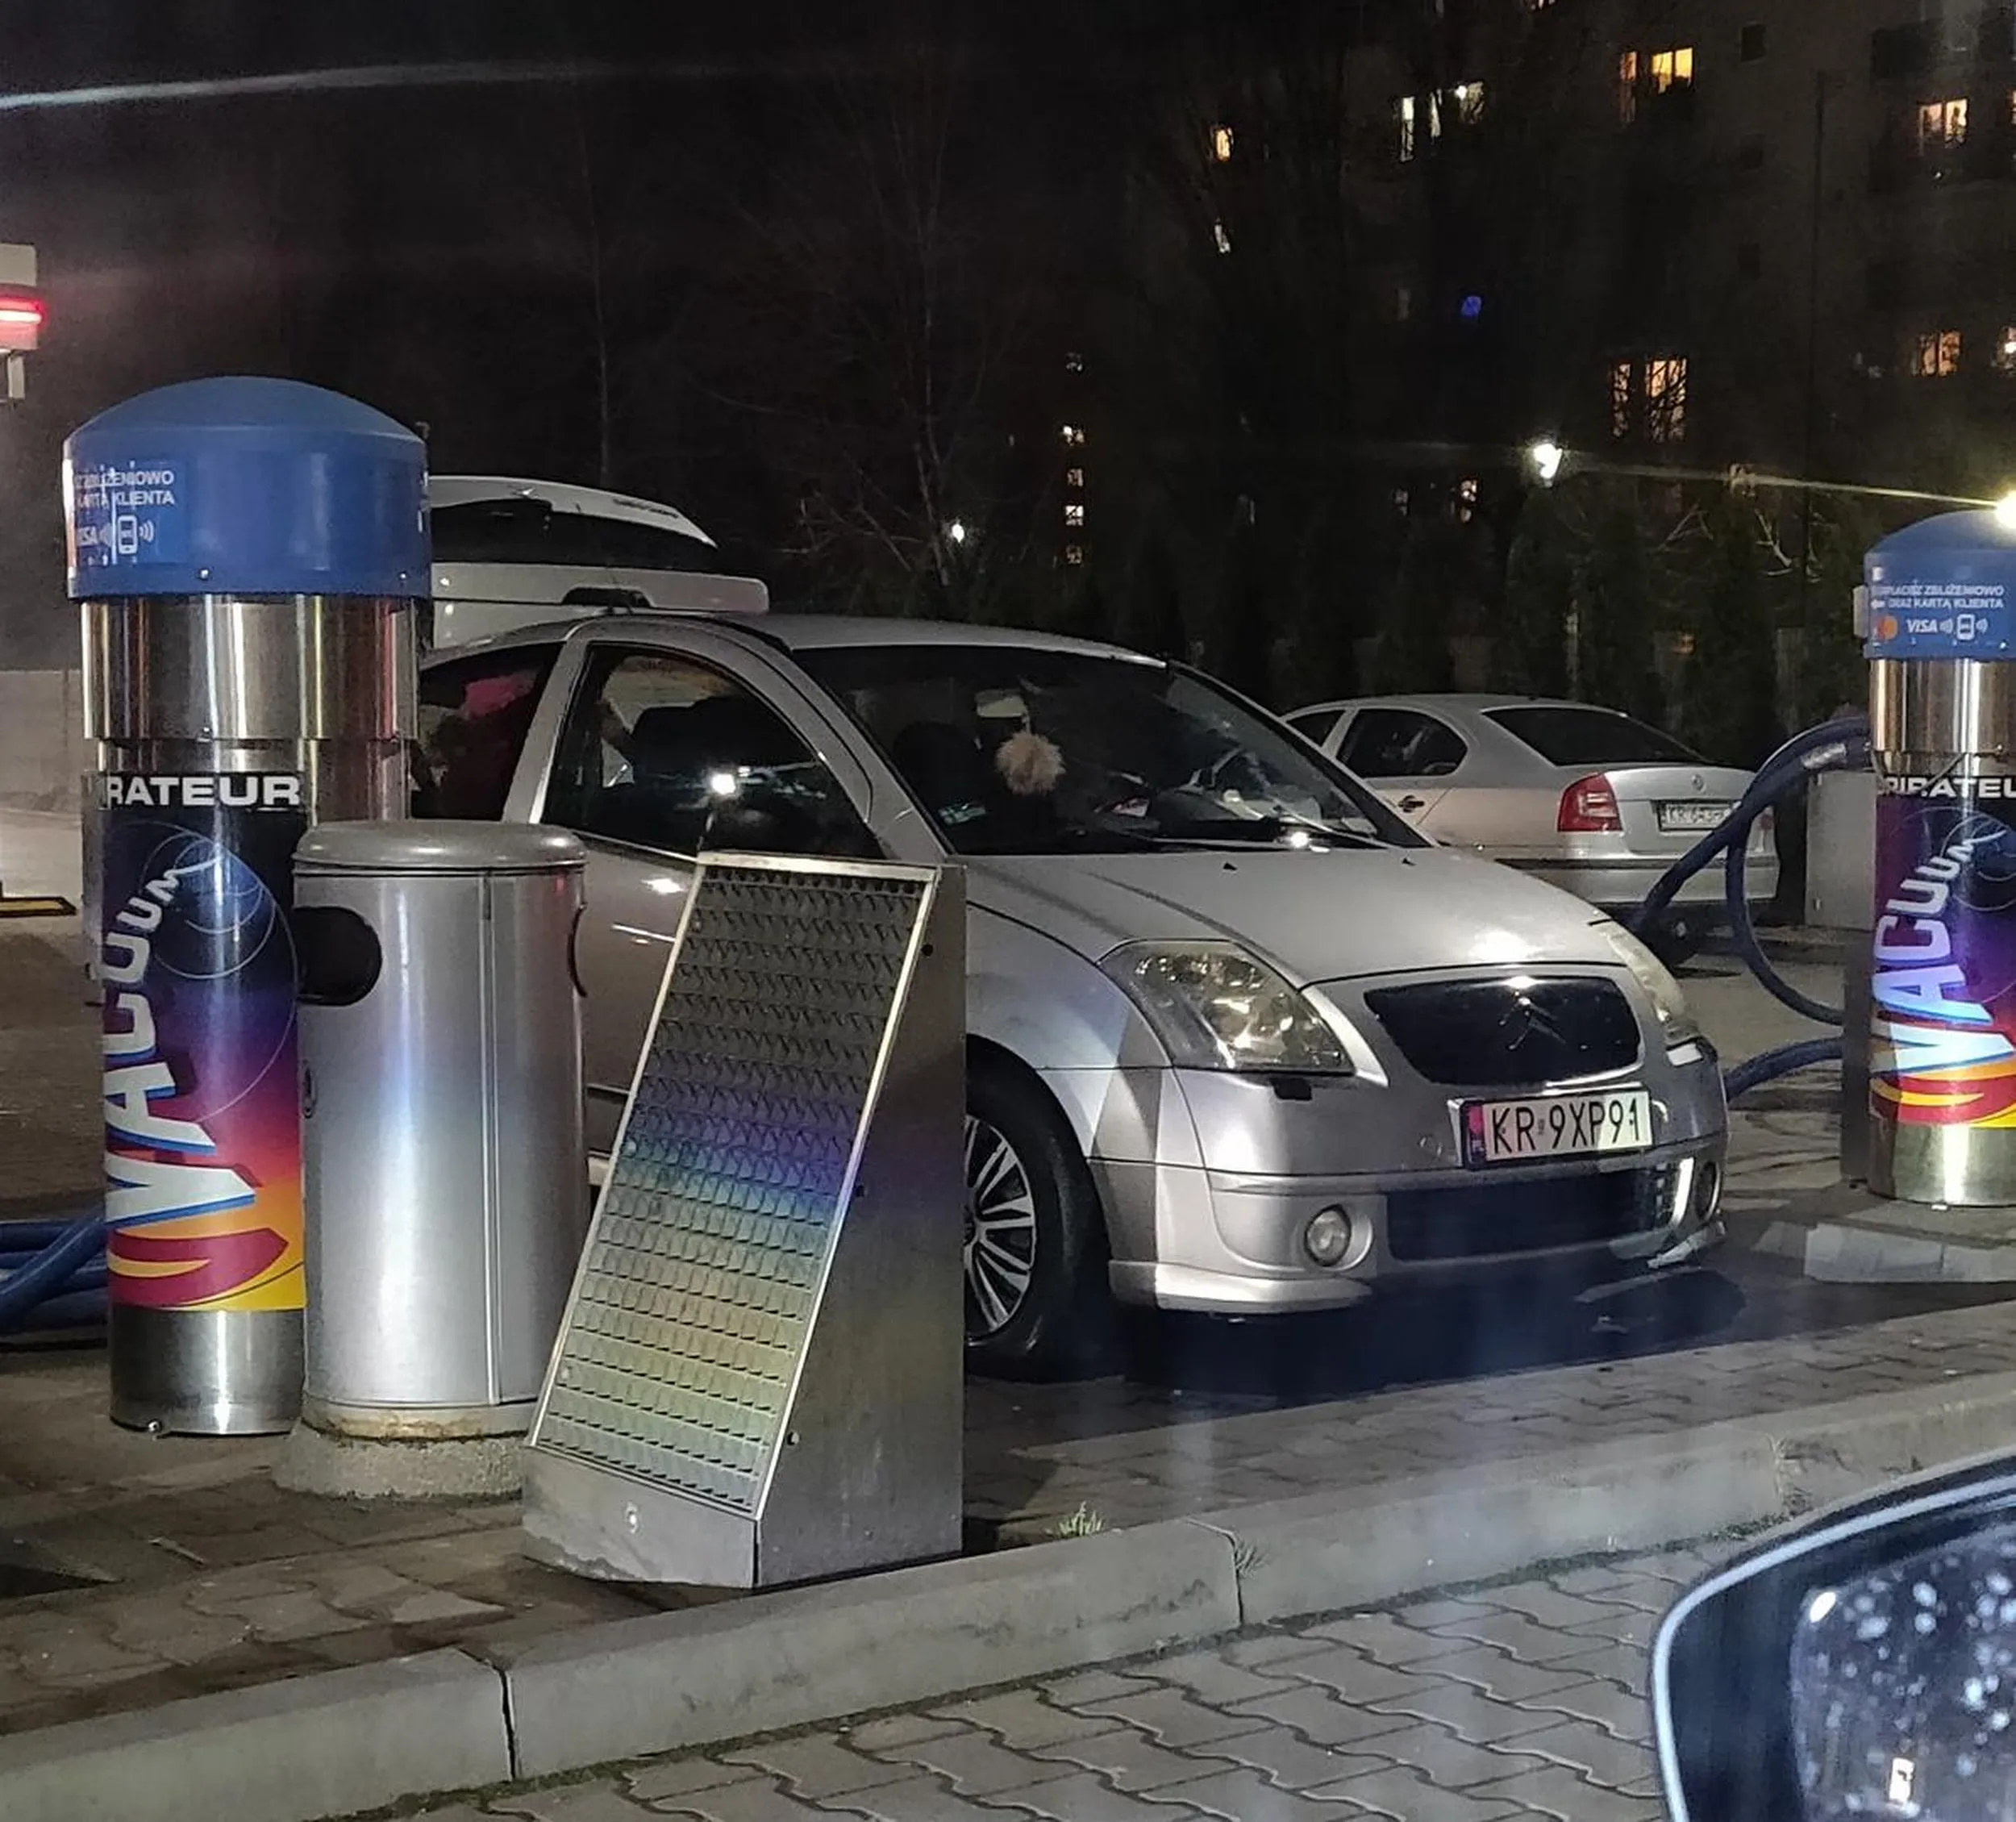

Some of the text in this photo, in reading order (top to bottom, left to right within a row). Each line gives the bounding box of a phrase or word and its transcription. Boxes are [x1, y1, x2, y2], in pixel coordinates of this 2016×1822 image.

[1906, 619, 1938, 633] VISA
[107, 776, 299, 806] RATEUR
[1492, 1098, 1640, 1154] KR 9XP91
